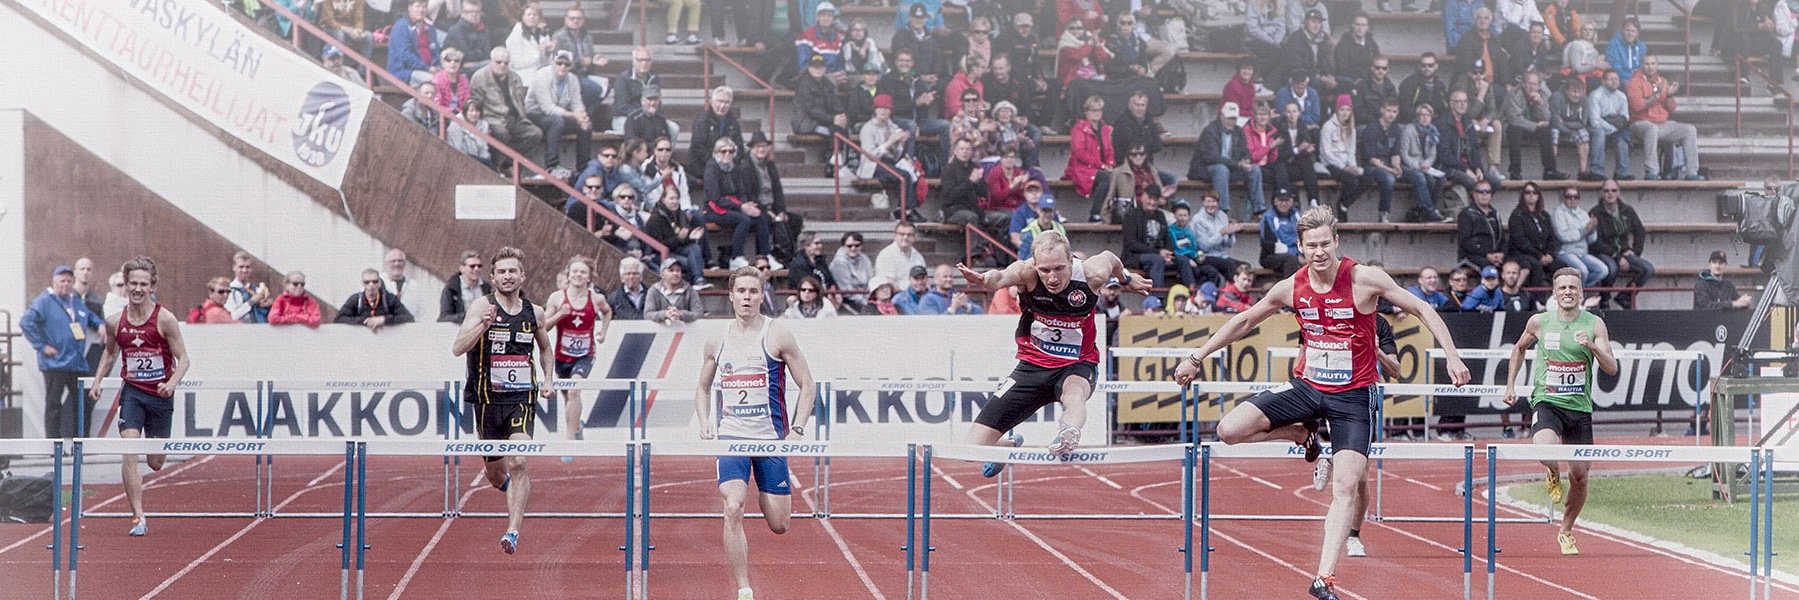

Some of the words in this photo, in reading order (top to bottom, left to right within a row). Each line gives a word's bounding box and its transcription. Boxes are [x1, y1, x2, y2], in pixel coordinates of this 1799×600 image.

[1036, 315, 1082, 328] motonet
[1051, 329, 1062, 342] 3
[570, 339, 583, 348] 20
[1308, 340, 1348, 349] motonet
[136, 359, 153, 370] 22
[1322, 352, 1329, 368] 1
[508, 369, 517, 382] 6
[1316, 371, 1350, 379] RAUTIA
[1559, 374, 1576, 385] 10
[722, 379, 764, 388] motonet
[738, 390, 748, 404] 2
[184, 390, 558, 437] LAAKKONN
[163, 442, 212, 451] KERKO
[216, 442, 266, 451] SPORT
[445, 443, 494, 452] KERKO
[498, 443, 546, 453] SPORT
[728, 443, 776, 453] KERKO
[781, 444, 829, 453] SPORT
[1008, 452, 1056, 461] KERKO
[1060, 452, 1108, 462] SPORT
[1574, 448, 1622, 458] KERKO
[1626, 448, 1673, 459] SPORT
